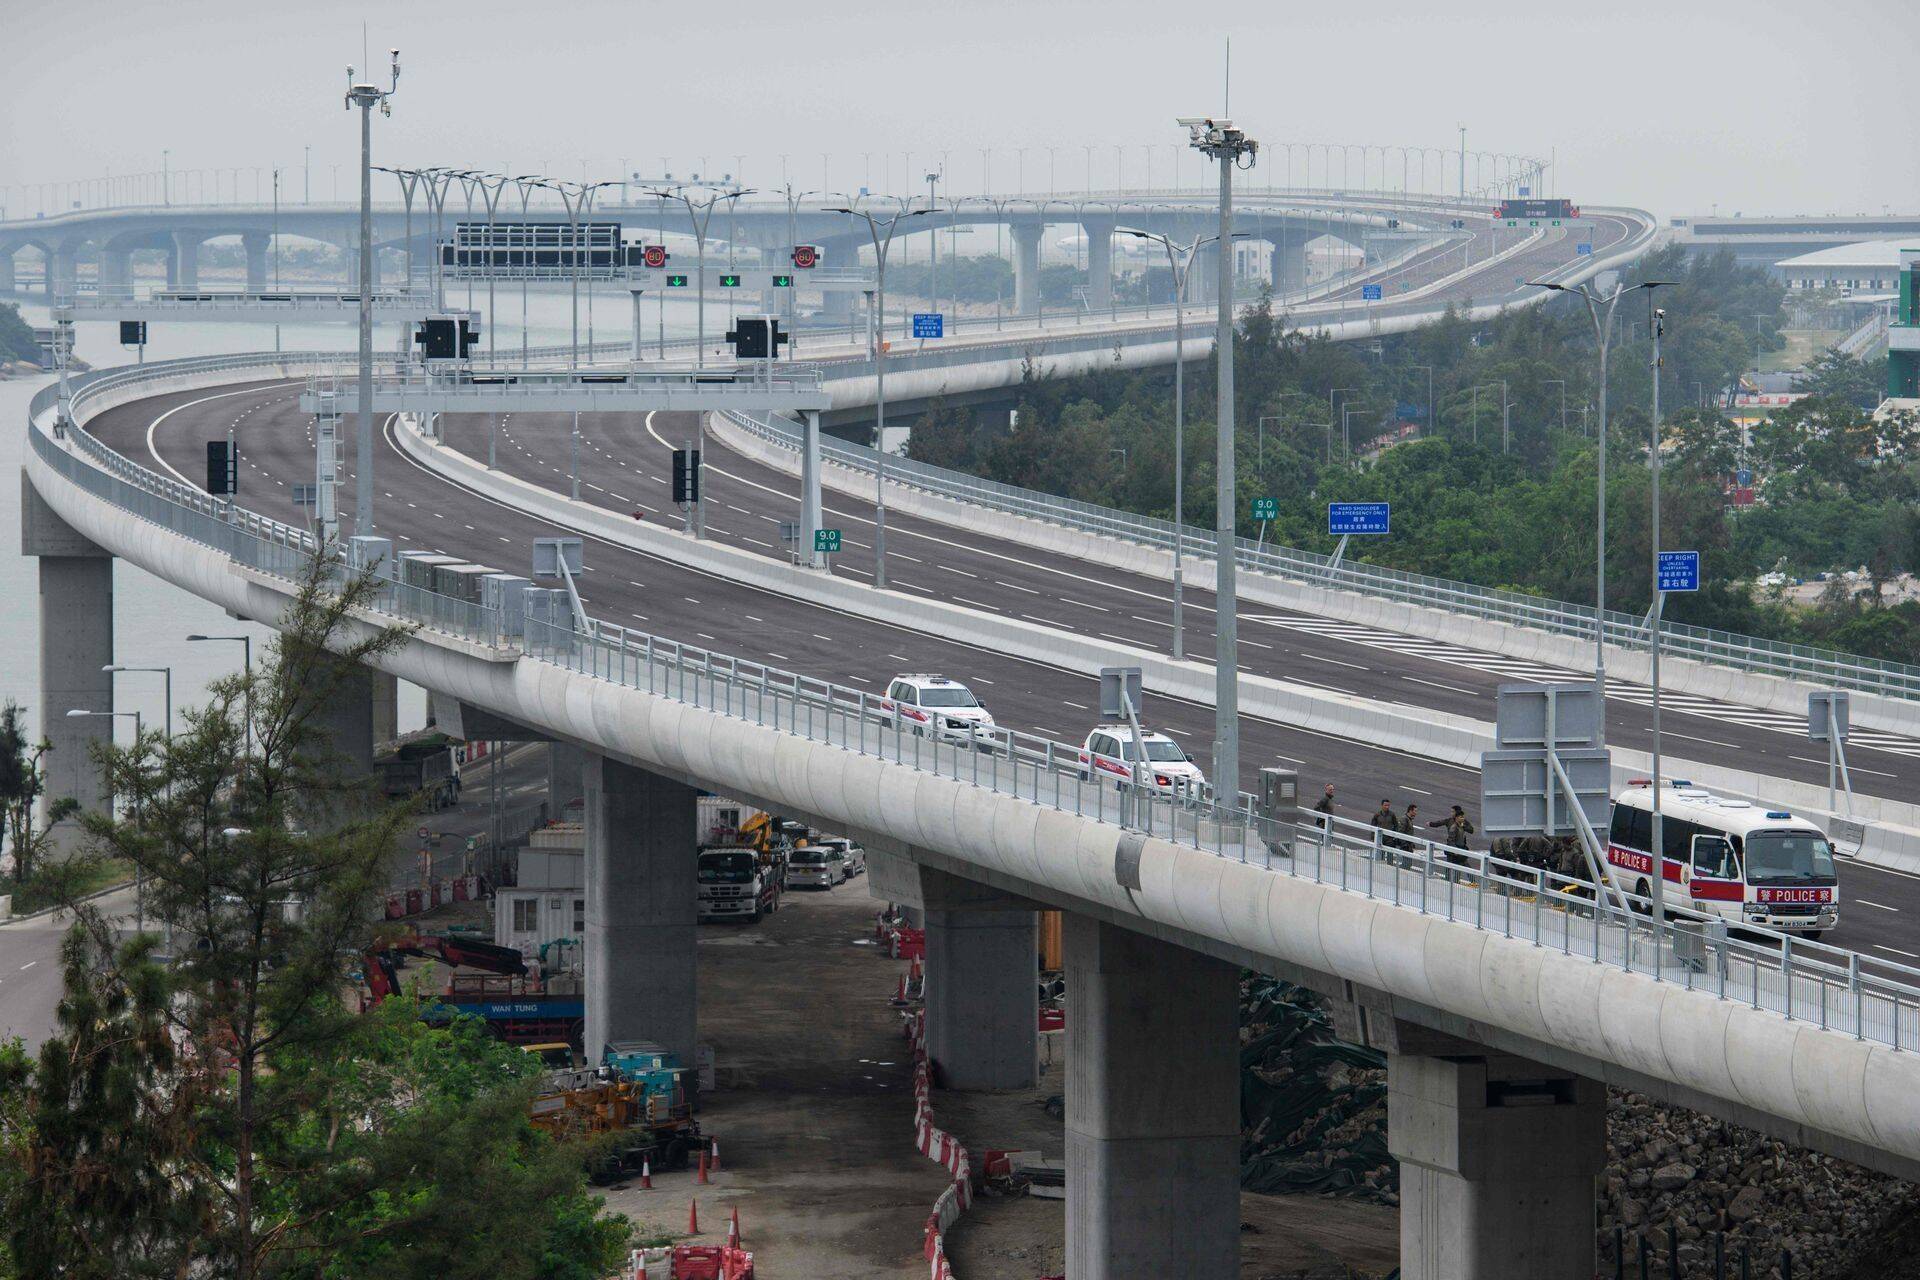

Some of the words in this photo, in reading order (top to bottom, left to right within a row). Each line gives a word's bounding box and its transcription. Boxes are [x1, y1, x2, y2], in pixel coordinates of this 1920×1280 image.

[1258, 500, 1272, 508] 9.0
[820, 530, 836, 540] 9.0
[1620, 852, 1640, 868] POLICE
[1761, 890, 1771, 901] 警
[1776, 890, 1815, 902] POLICE
[1820, 890, 1829, 901] 察
